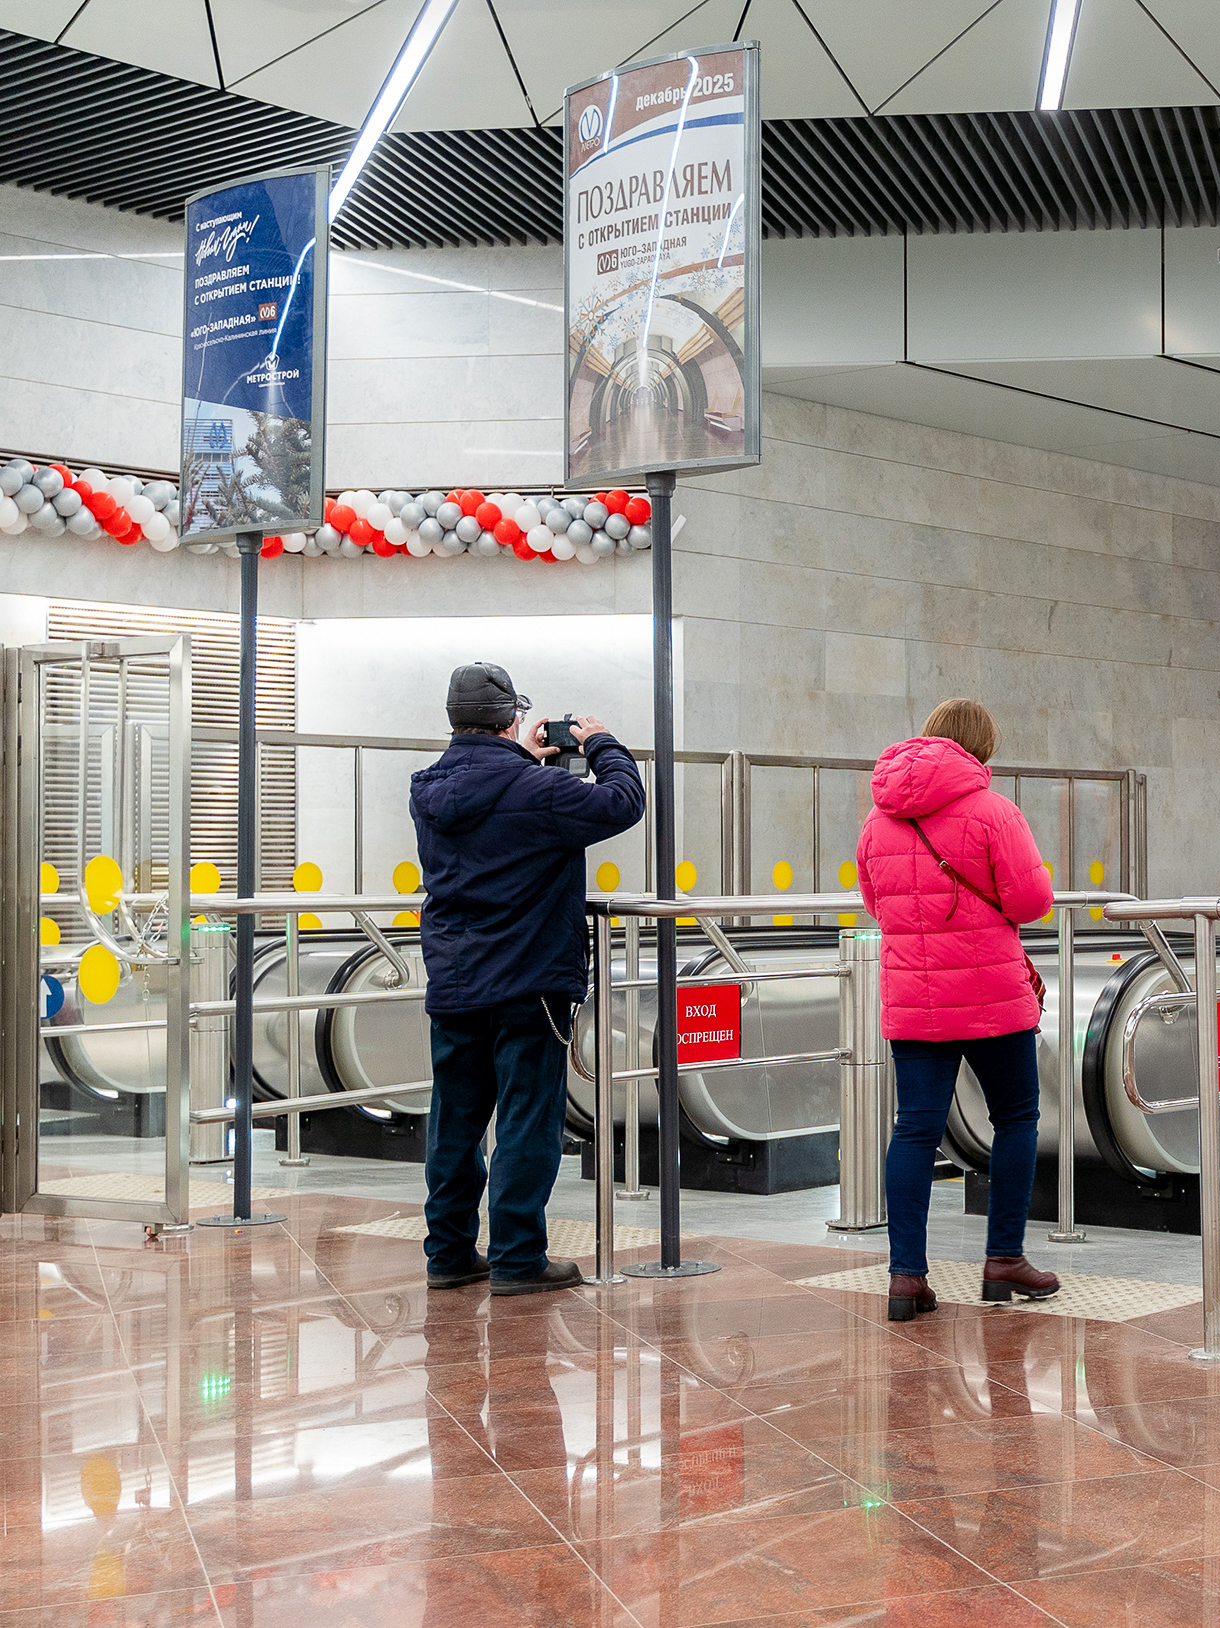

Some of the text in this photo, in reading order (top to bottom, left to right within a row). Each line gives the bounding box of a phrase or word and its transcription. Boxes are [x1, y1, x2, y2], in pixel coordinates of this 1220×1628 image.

[636, 72, 734, 111] декабрь 2025
[577, 159, 732, 224] ПОЗДРАВЛЯЕМ
[195, 211, 242, 232] С наступающим
[578, 202, 732, 249] С ОТКРЫТИЕМ СТАНЦИИ
[620, 236, 687, 259] ЮГО-ЗАПДНАЯ
[620, 252, 671, 269] YUGO-ZAPADAYA
[194, 264, 250, 289] ПОЗДРАВЛЯЕМ
[194, 295, 200, 305] С
[200, 282, 247, 303] ОТКРЫТИЕМ
[190, 314, 256, 338] «ЮГО-ЗАПАДНАЯ»
[246, 368, 300, 384] МЕТРОСТРОЙ
[685, 1004, 717, 1018] ВХОД
[677, 1029, 734, 1045] ОСПРЕЩЕН
